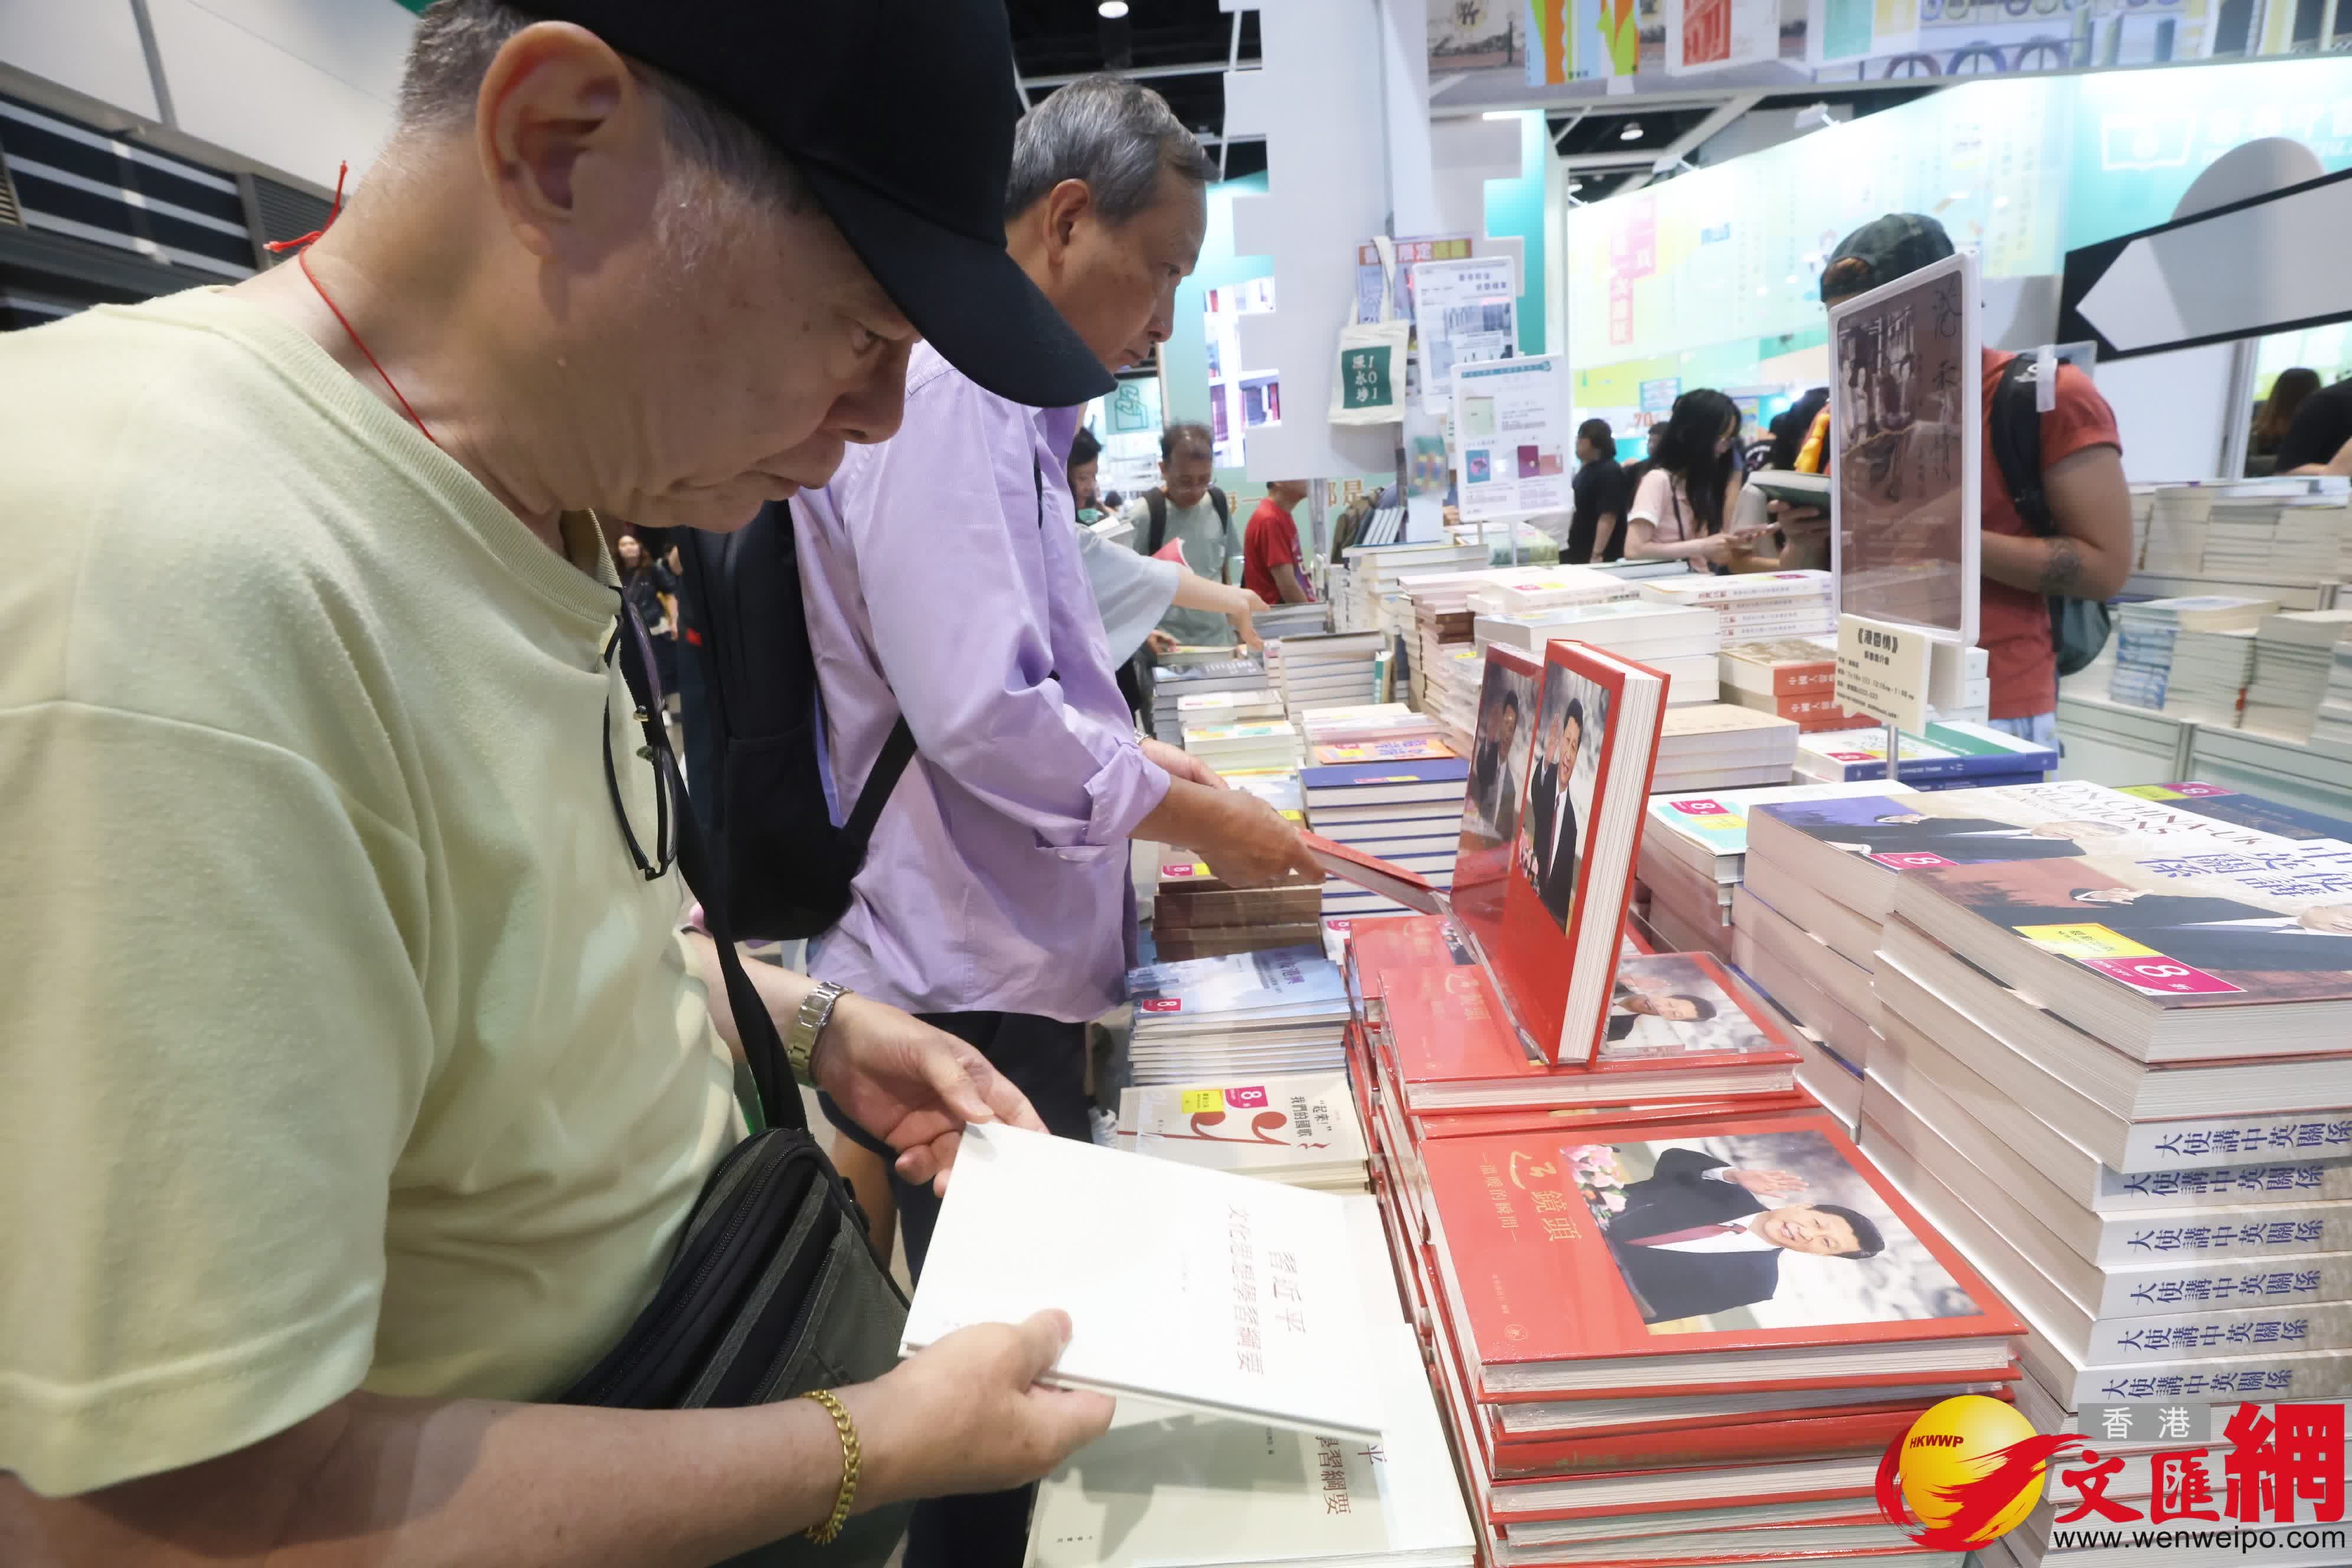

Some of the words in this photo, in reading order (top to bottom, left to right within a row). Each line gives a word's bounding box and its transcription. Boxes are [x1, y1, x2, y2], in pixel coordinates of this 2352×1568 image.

[2021, 787, 2181, 835] RELATIONS
[2134, 965, 2190, 978] 8
[1240, 1090, 1262, 1100] 8
[2155, 1120, 2352, 1158] 大使講中英關係
[2123, 1165, 2325, 1198] 大使講中英關係
[2127, 1220, 2324, 1253] 大使講中英關係
[1268, 1250, 1307, 1335] 習近平
[2129, 1270, 2321, 1305] 大使講中英關係
[2117, 1319, 2309, 1352] 大使講中英關係
[2101, 1369, 2294, 1400] 大使講中英關係
